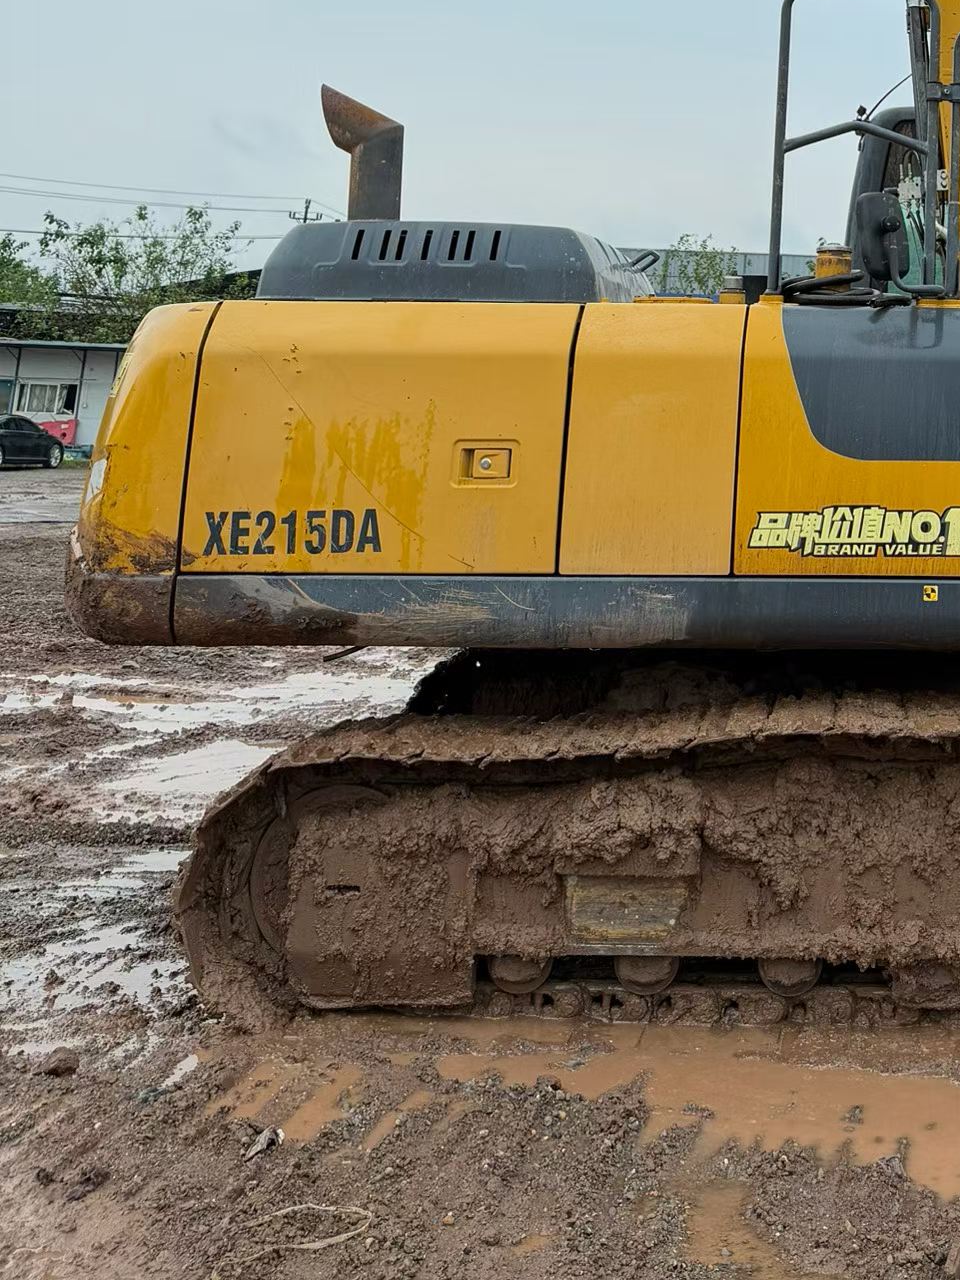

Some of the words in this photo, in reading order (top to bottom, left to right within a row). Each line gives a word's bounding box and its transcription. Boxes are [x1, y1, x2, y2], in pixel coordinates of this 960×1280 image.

[202, 508, 382, 556] XE215DA
[813, 543, 876, 556] BRAND
[885, 543, 943, 556] VALUE
